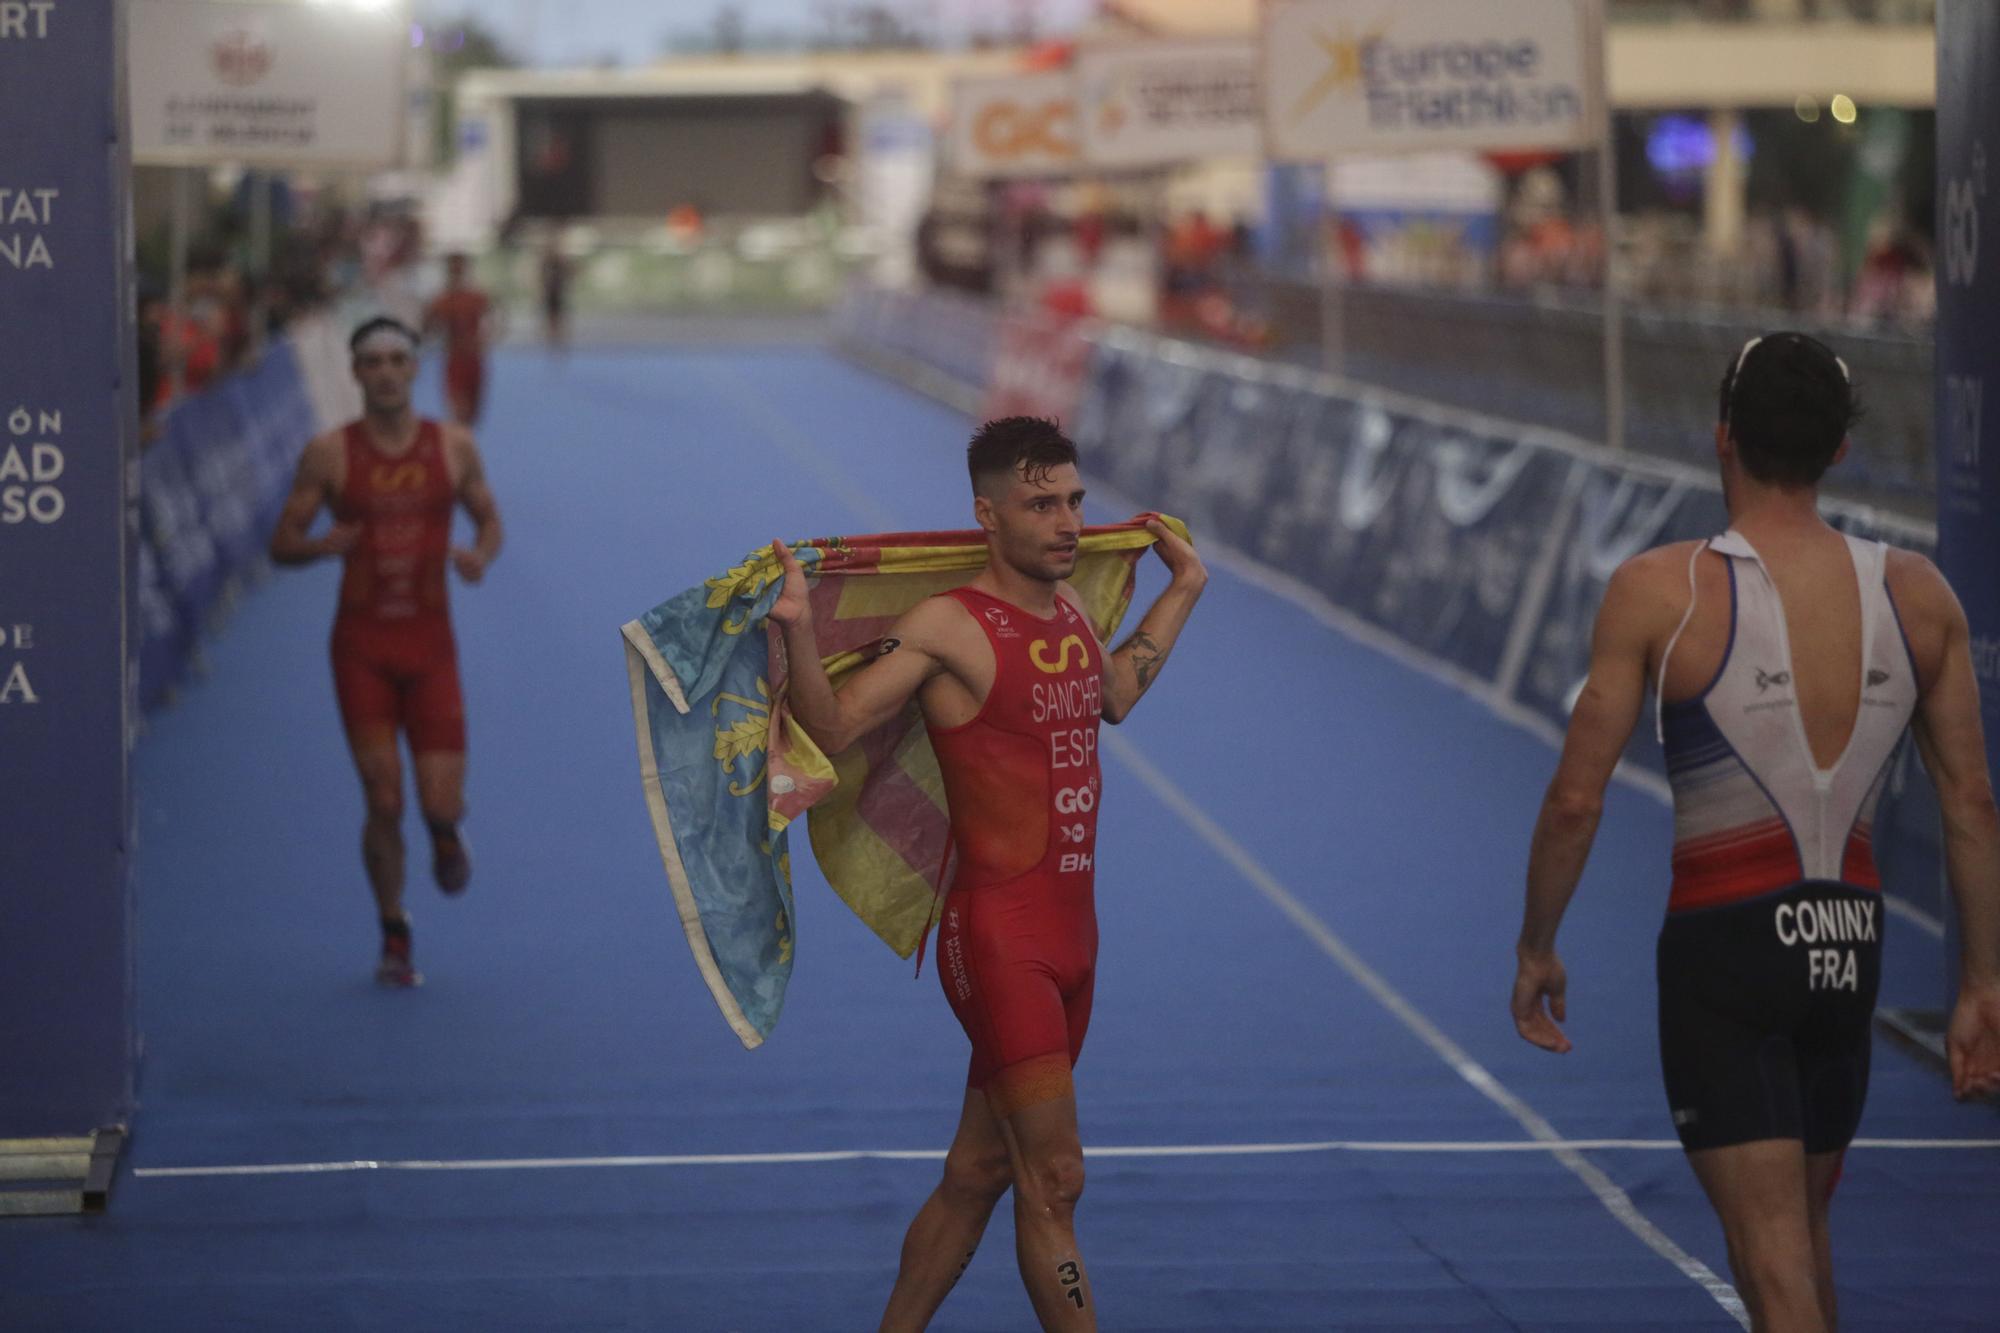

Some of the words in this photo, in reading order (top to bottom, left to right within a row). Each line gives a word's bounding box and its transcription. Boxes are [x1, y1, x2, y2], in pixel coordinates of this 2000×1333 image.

[1360, 38, 1538, 85] Europe
[2, 485, 65, 524] SO
[1051, 727, 1095, 769] ESP
[1055, 785, 1094, 814] GO
[1059, 853, 1093, 873] BH
[1775, 900, 1877, 946] CONINX
[1808, 949, 1857, 992] FRA
